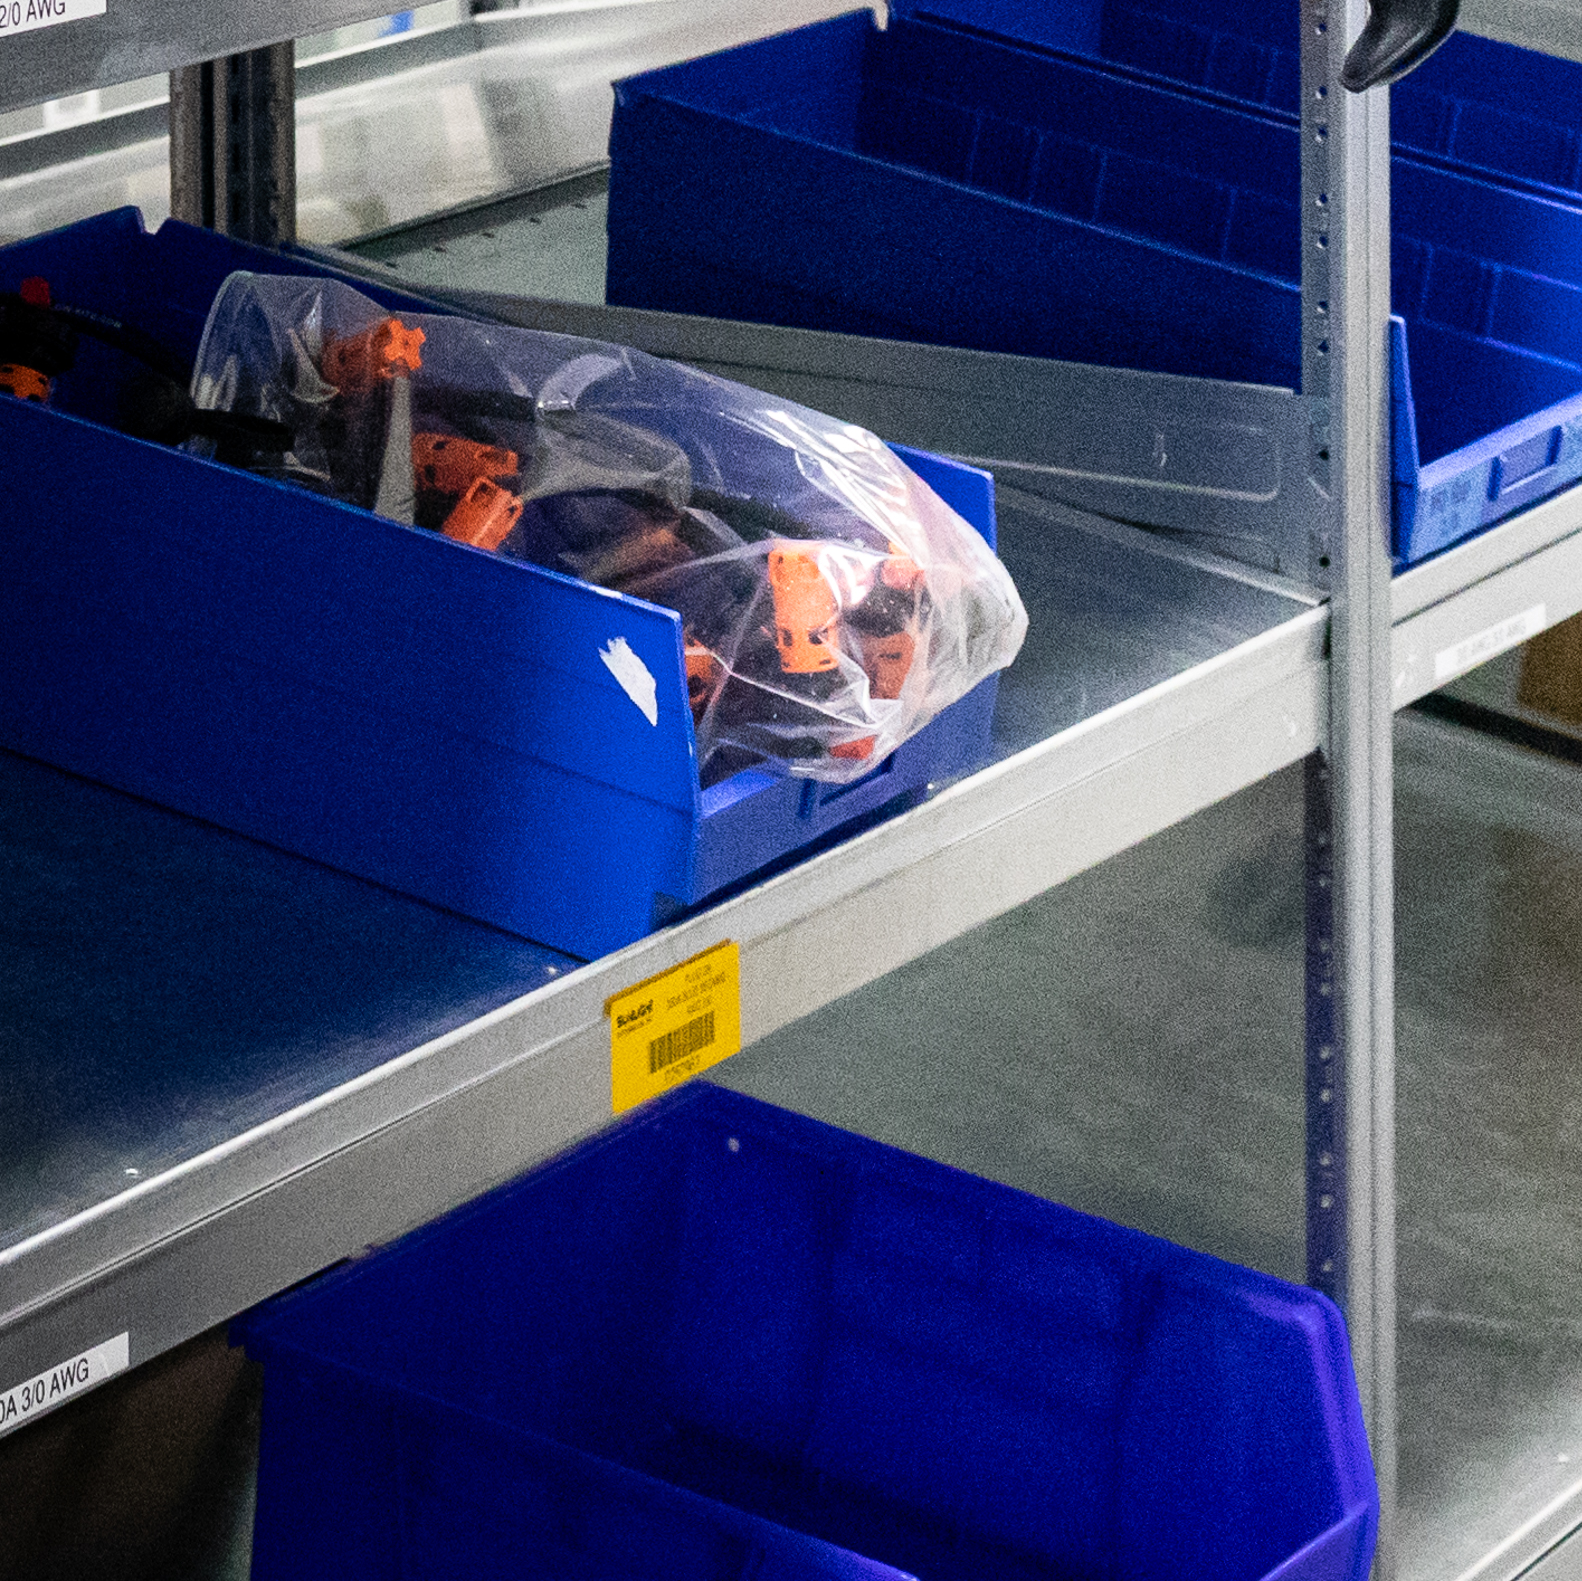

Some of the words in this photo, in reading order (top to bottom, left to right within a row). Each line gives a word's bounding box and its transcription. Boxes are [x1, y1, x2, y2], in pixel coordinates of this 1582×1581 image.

[0, 1, 21, 28] 2/0
[21, 1379, 46, 1412] 3/0
[50, 1358, 89, 1398] AWG
